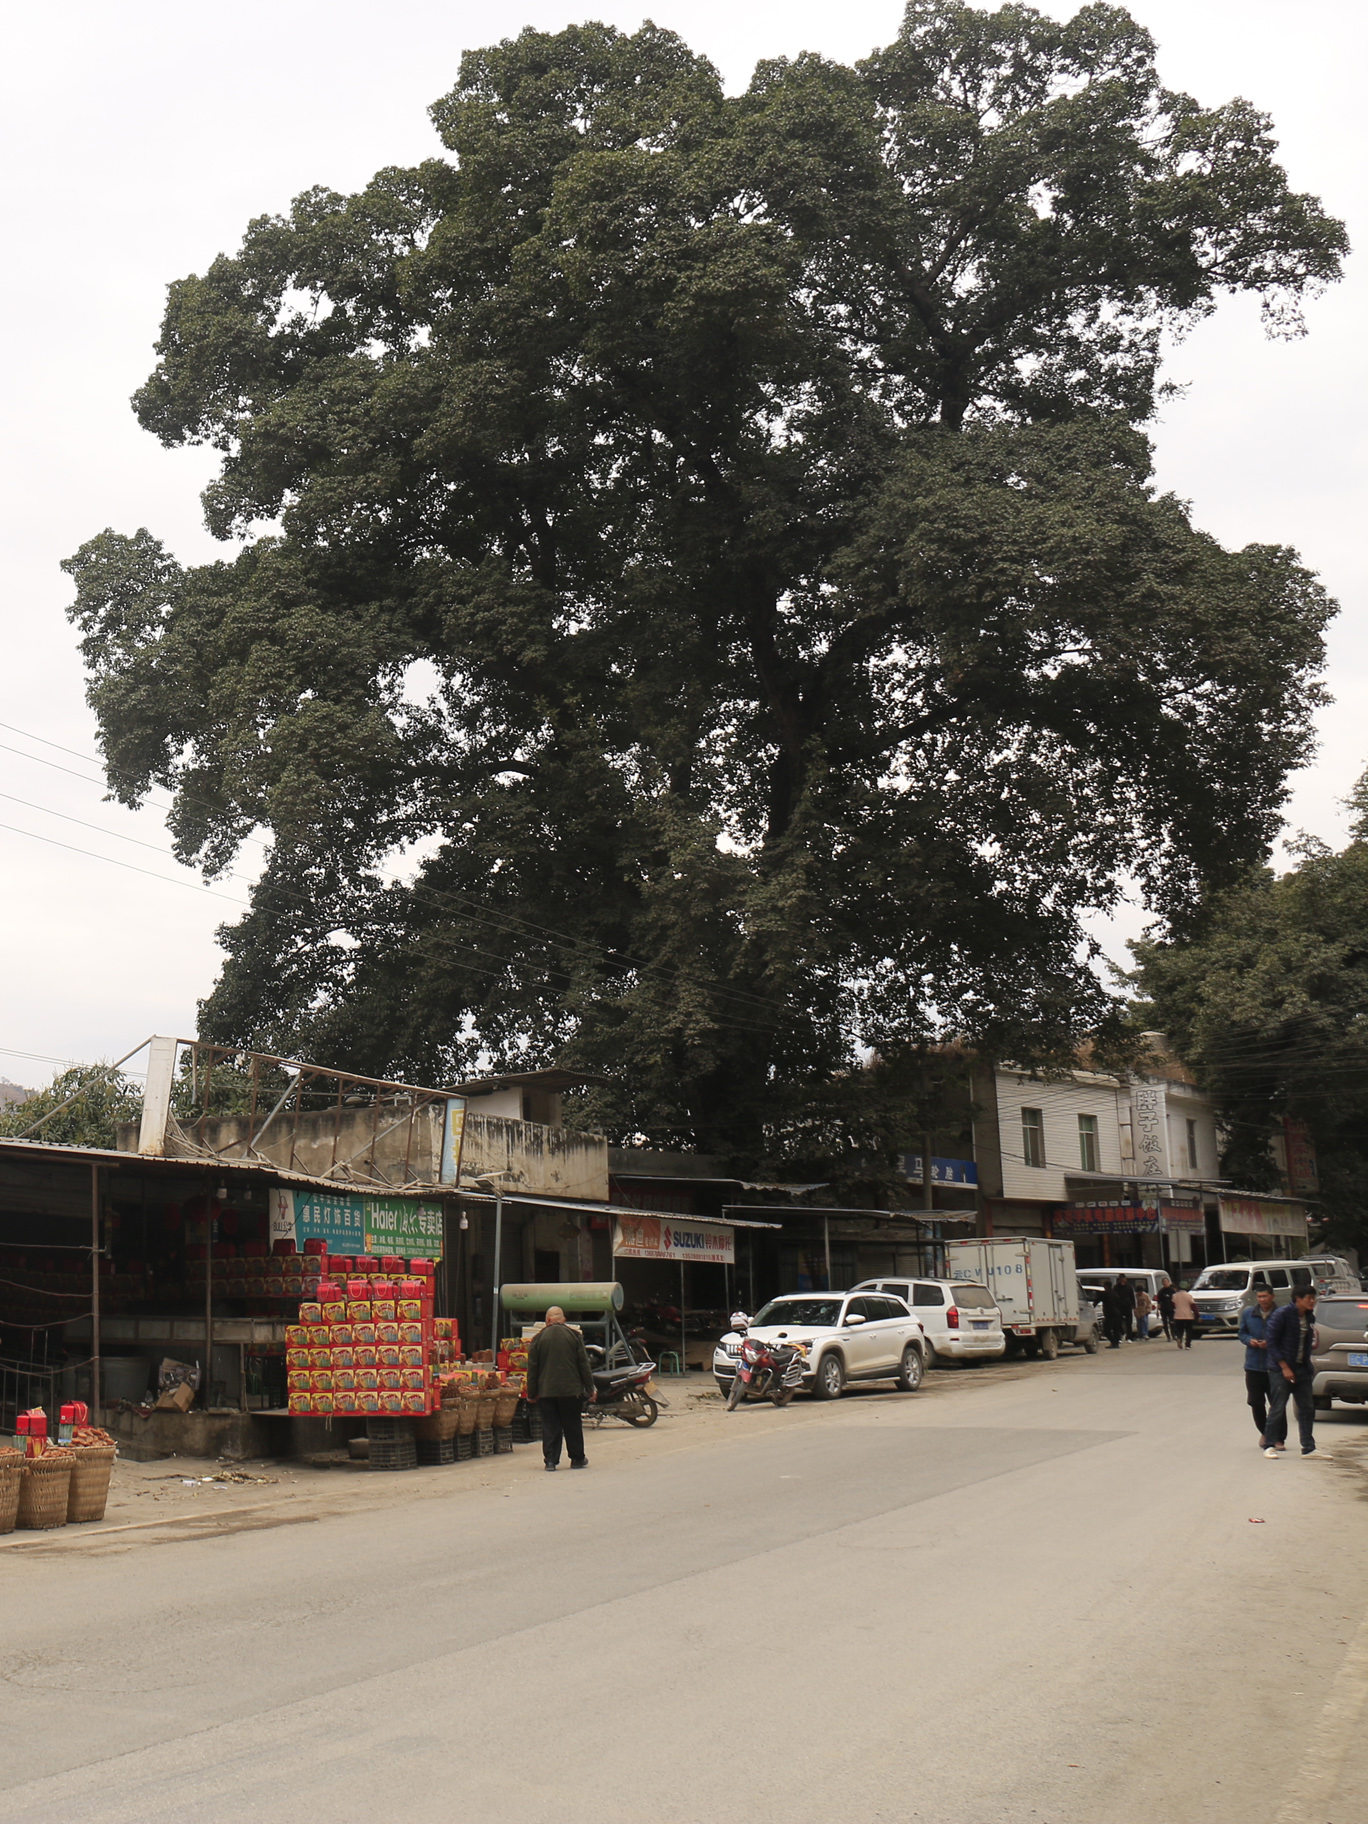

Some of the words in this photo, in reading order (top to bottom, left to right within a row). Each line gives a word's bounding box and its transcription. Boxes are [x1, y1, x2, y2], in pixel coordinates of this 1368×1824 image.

[1136, 1090, 1162, 1176] 胖子饭庄
[302, 1205, 361, 1227] 惠民灯饰百货
[371, 1202, 398, 1231] Haier
[673, 1231, 704, 1249] SUZUKI
[705, 1233, 732, 1251] 铃木摩托
